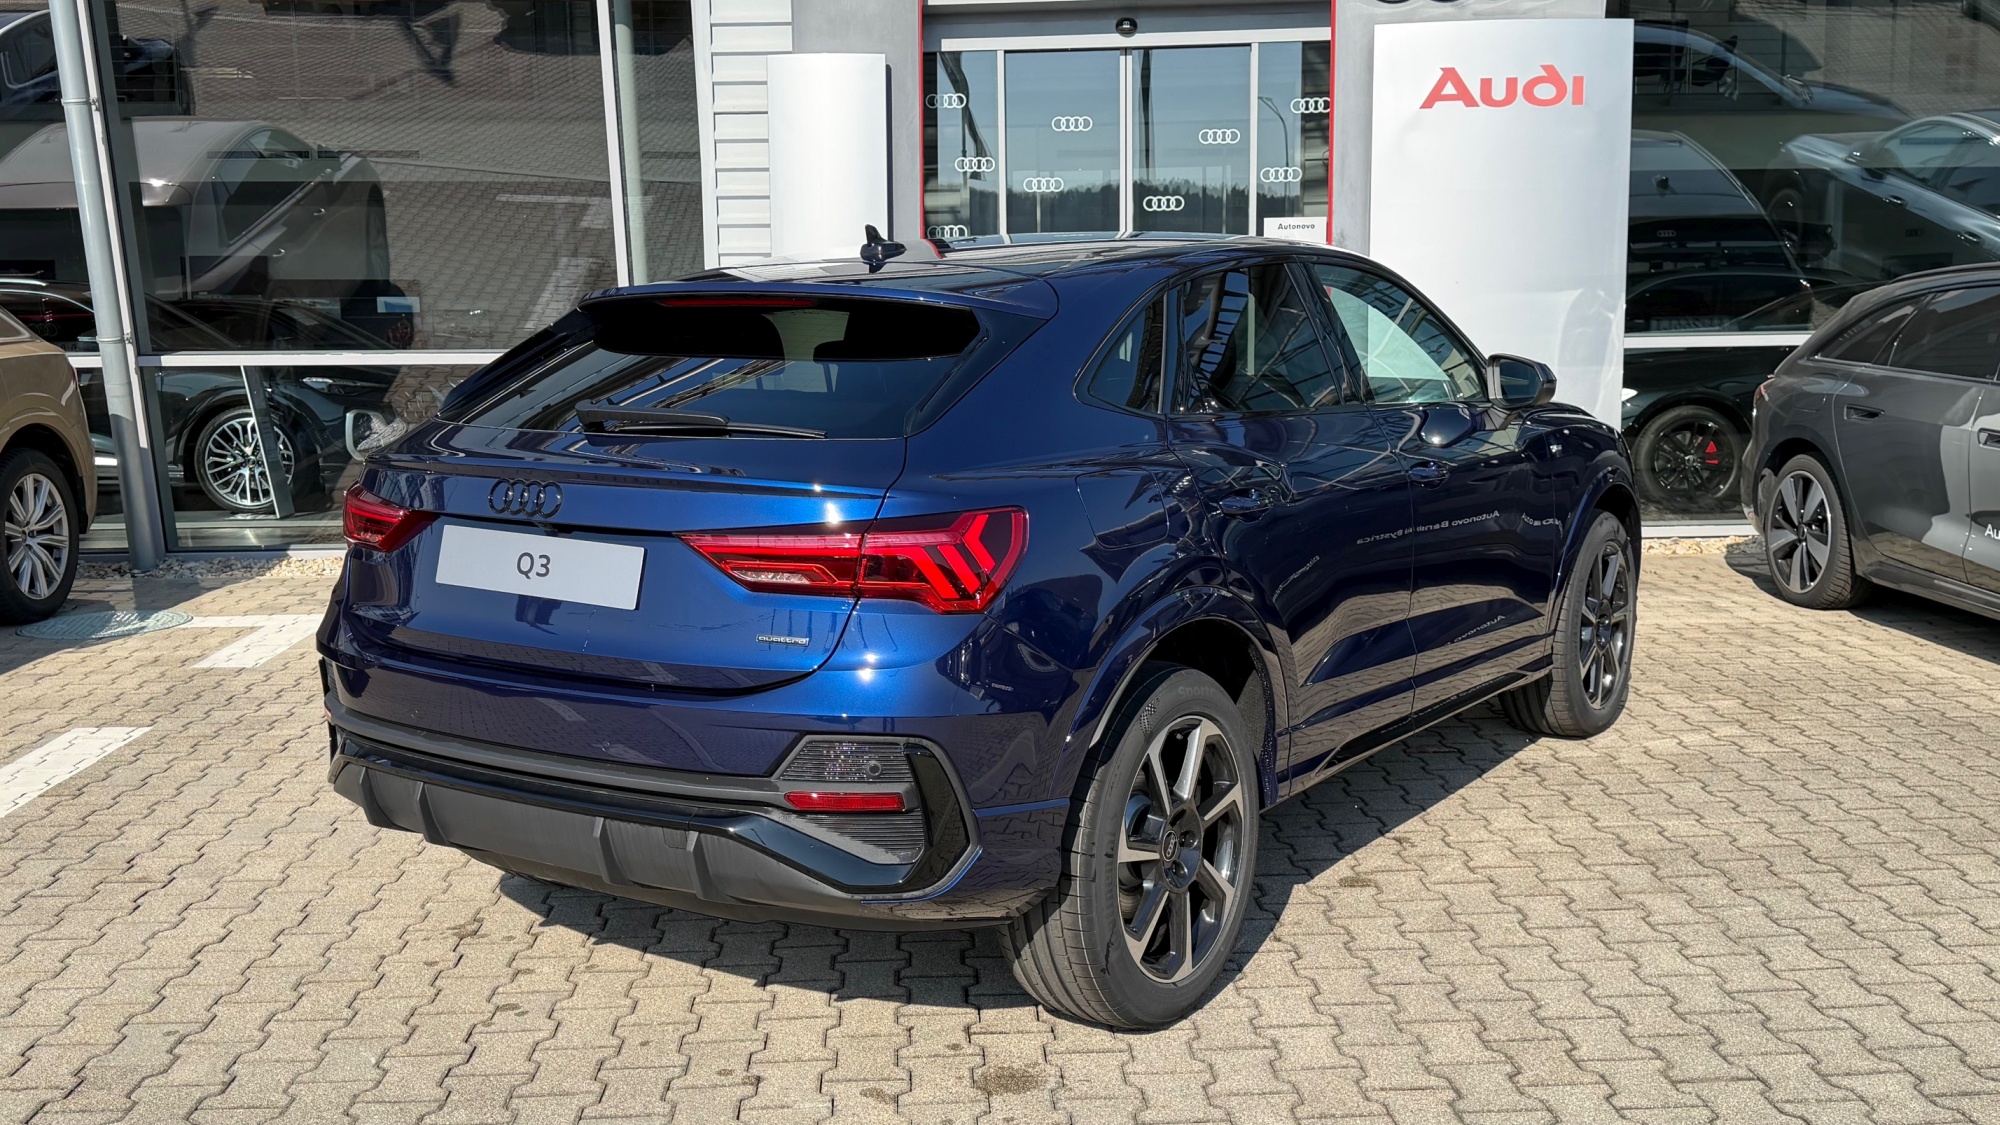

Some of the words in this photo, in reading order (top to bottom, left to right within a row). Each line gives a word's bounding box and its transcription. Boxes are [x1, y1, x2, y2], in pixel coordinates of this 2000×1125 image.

[1419, 64, 1585, 109] Audi
[1278, 222, 1316, 230] Autonovo
[516, 551, 551, 580] Q3
[757, 635, 807, 645] quattro
